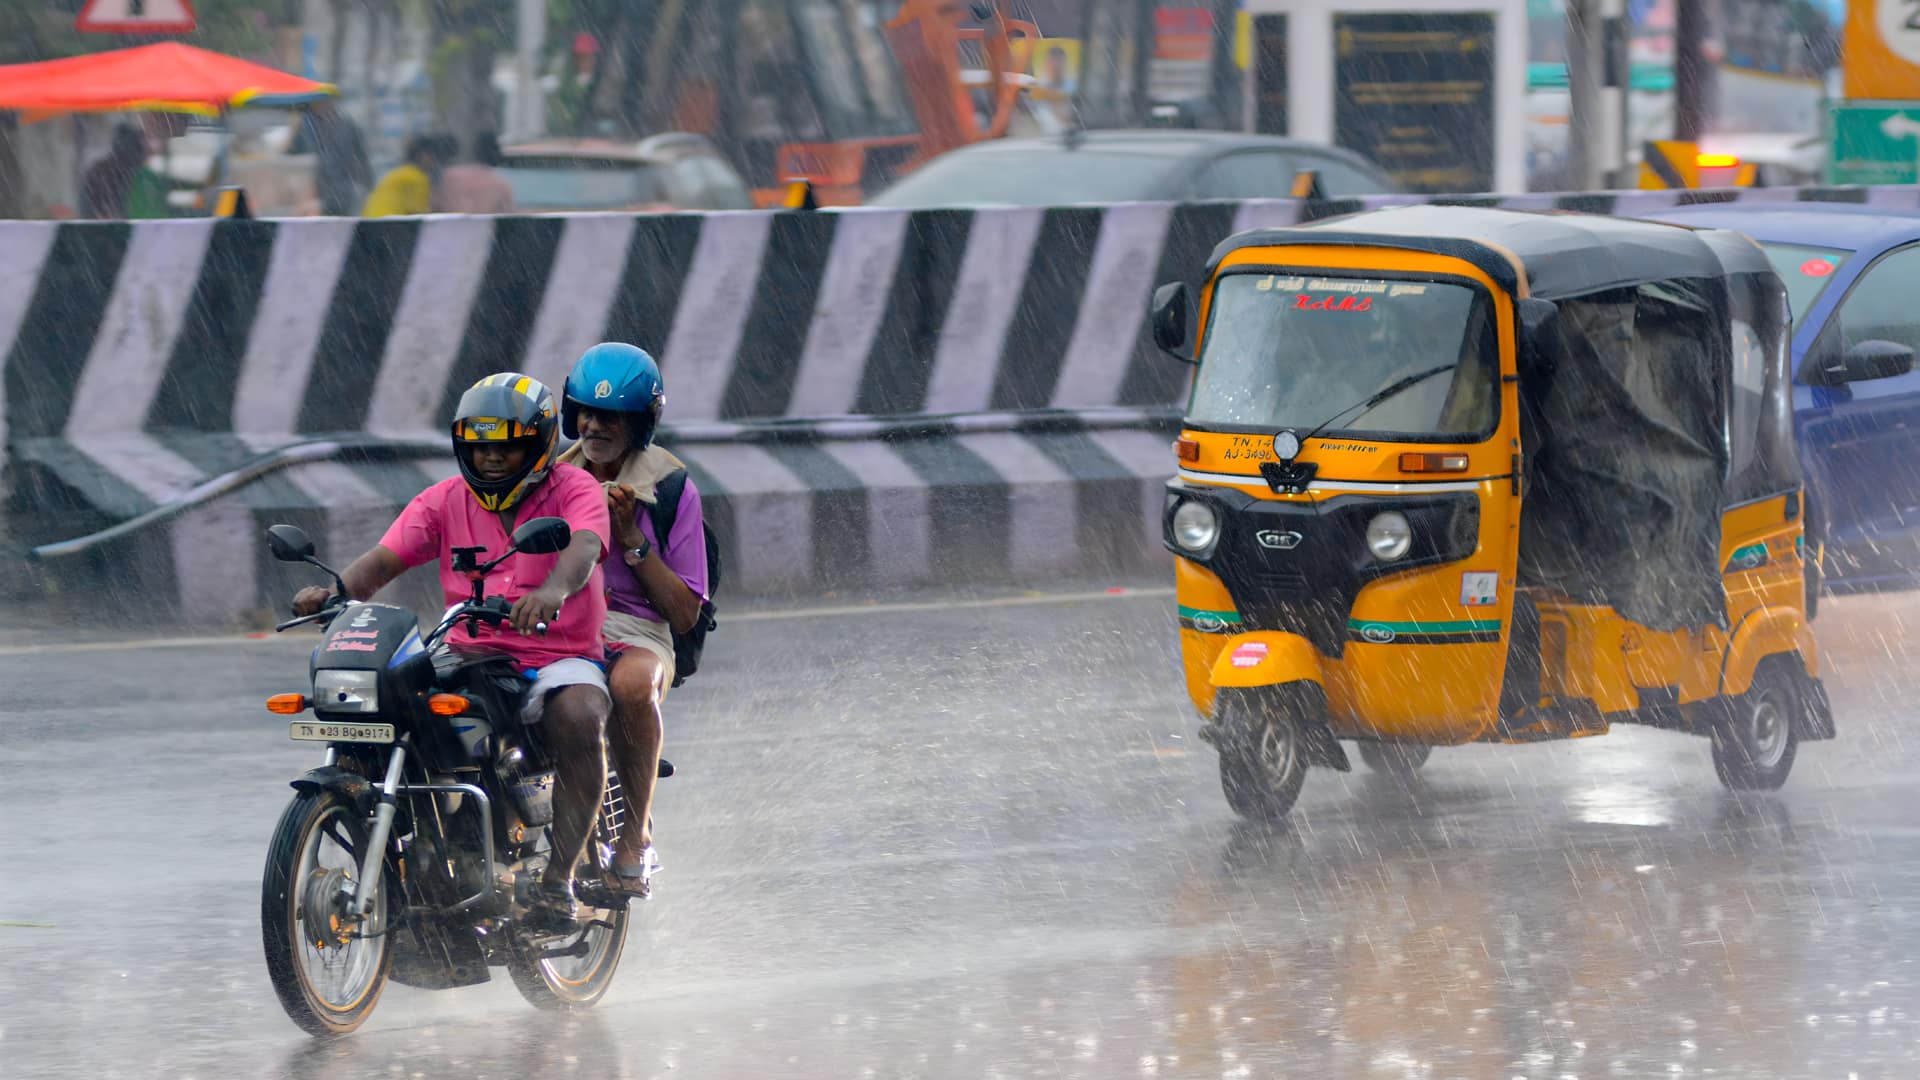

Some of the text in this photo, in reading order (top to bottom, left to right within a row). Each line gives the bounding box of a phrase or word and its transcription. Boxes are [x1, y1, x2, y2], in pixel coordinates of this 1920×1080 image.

[300, 726, 314, 736] TN
[326, 726, 339, 737] 23
[364, 728, 390, 739] 9174
